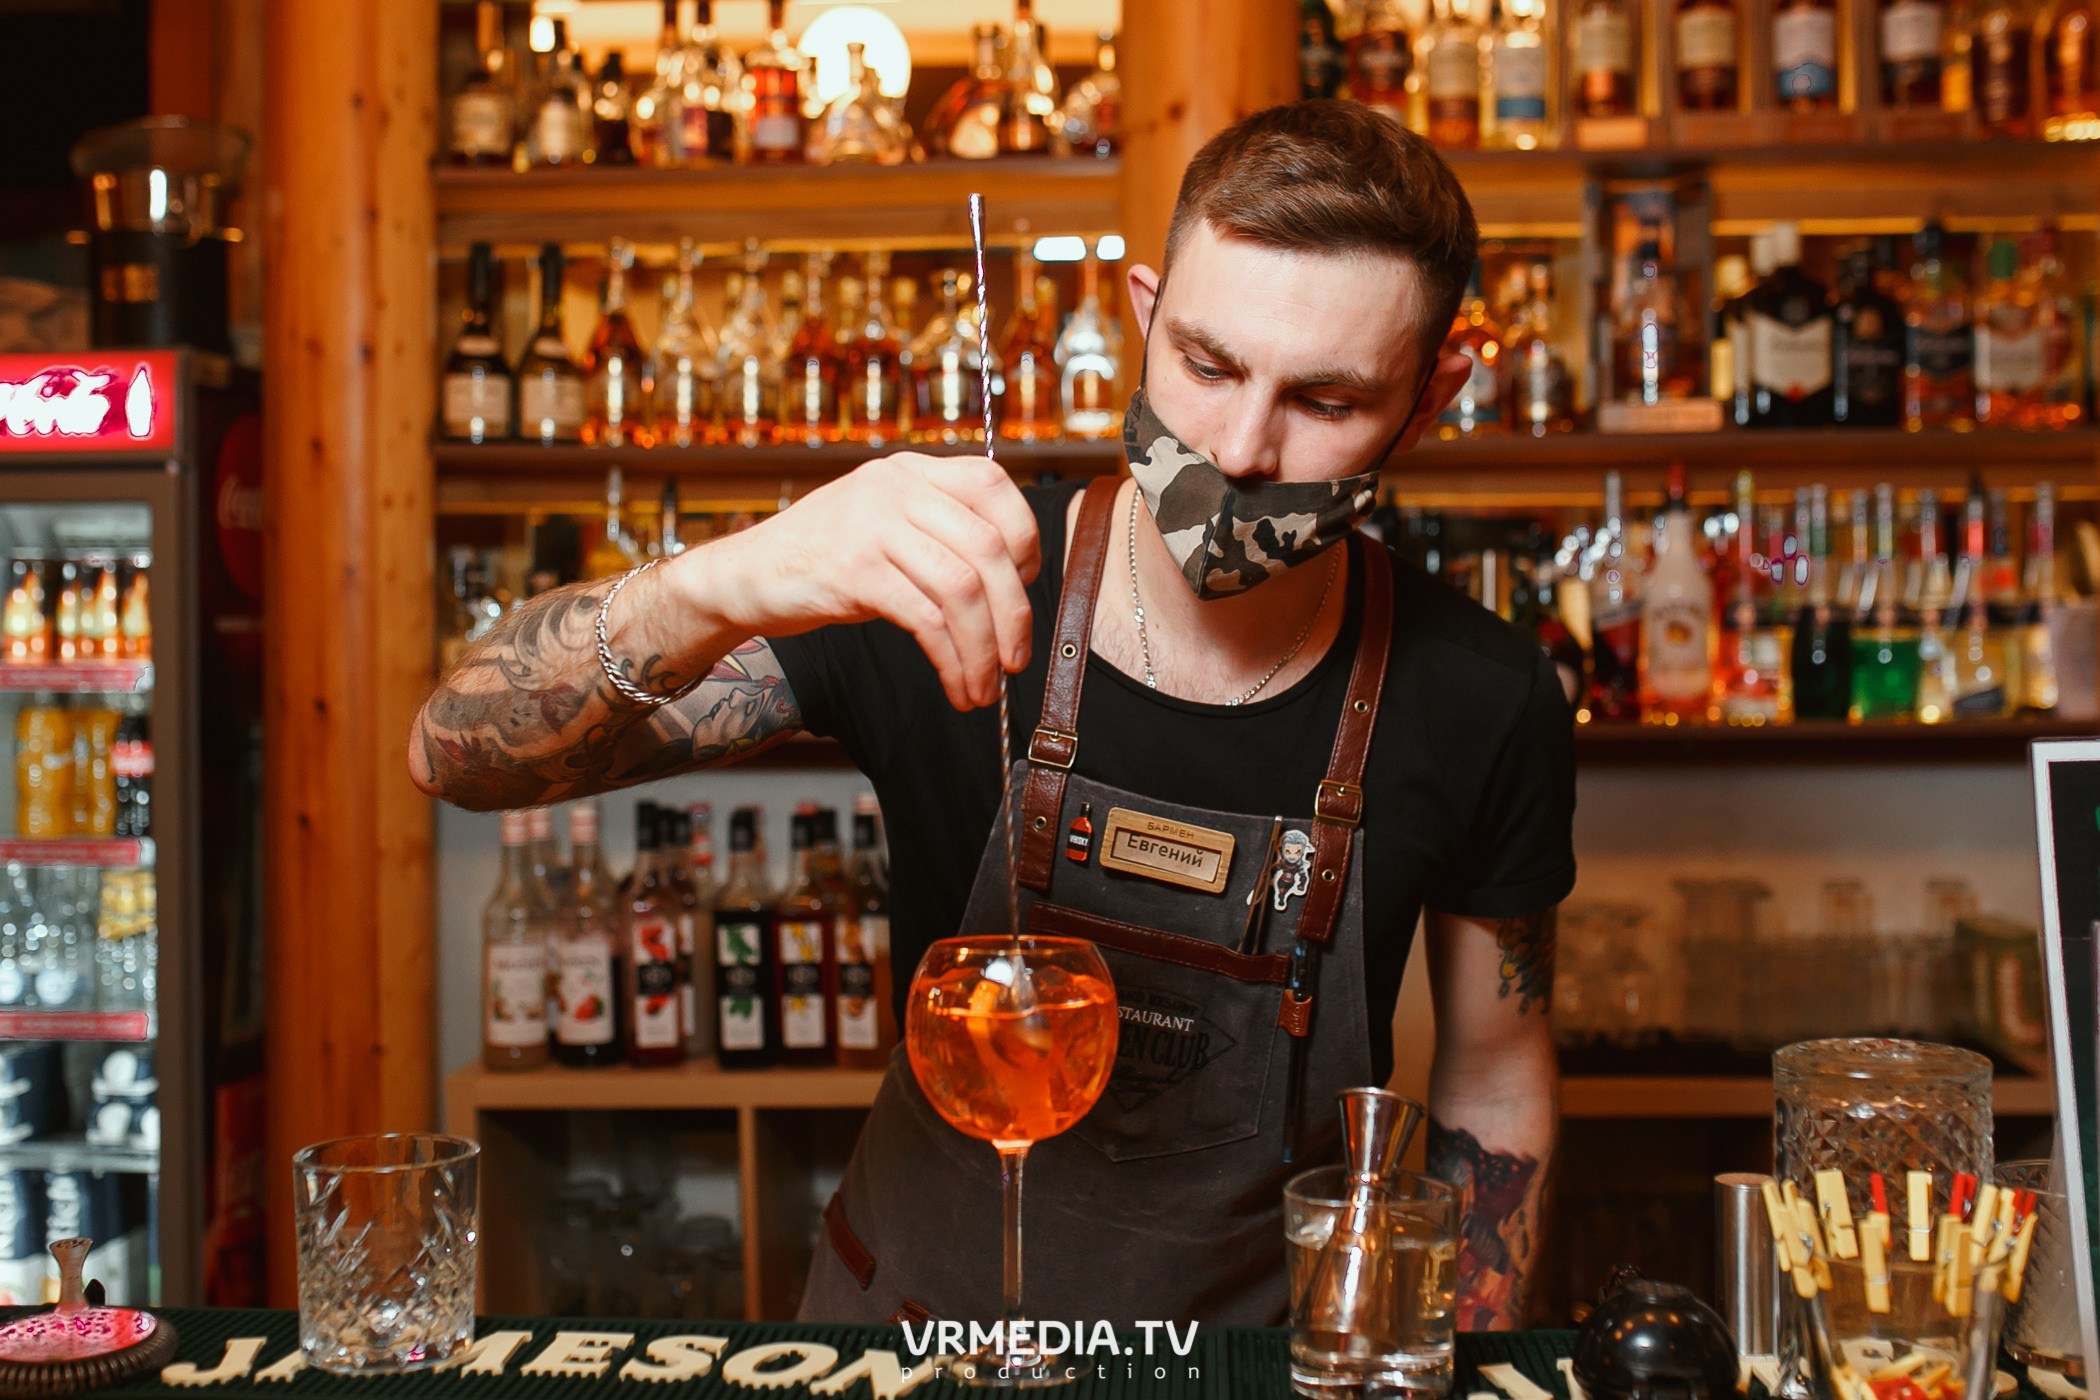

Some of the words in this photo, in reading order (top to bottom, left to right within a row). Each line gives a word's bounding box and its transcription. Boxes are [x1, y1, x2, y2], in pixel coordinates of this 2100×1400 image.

[1147, 821, 1195, 839] БАРМЕН
[1127, 832, 1203, 868] Евгений
[1118, 1006, 1195, 1032] STAURANT
[1118, 1024, 1151, 1062] EN
[1151, 1031, 1211, 1071] CLUB
